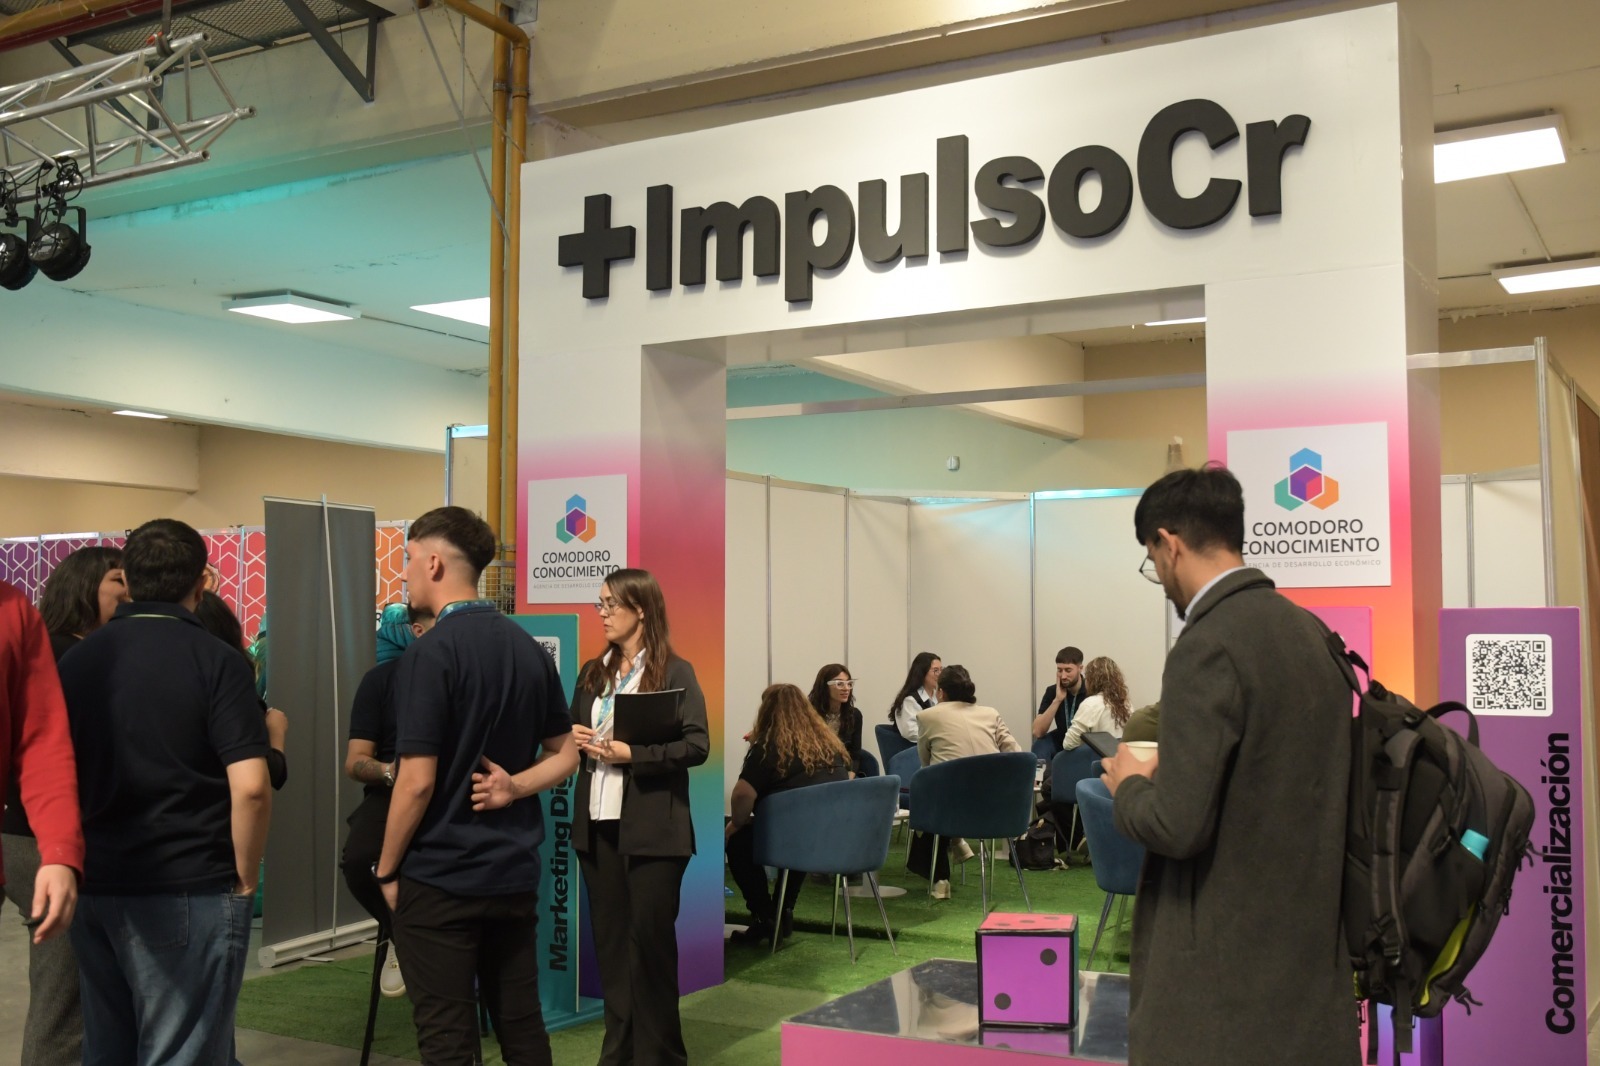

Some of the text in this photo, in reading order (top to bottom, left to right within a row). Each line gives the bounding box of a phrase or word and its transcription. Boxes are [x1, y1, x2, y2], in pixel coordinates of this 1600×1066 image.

[558, 98, 1311, 304] +ImpulsoCr
[542, 550, 611, 563] COMODORO
[1252, 519, 1363, 536] COMODORO
[549, 821, 573, 972] Marketing
[1540, 732, 1576, 1035] Comercialización
